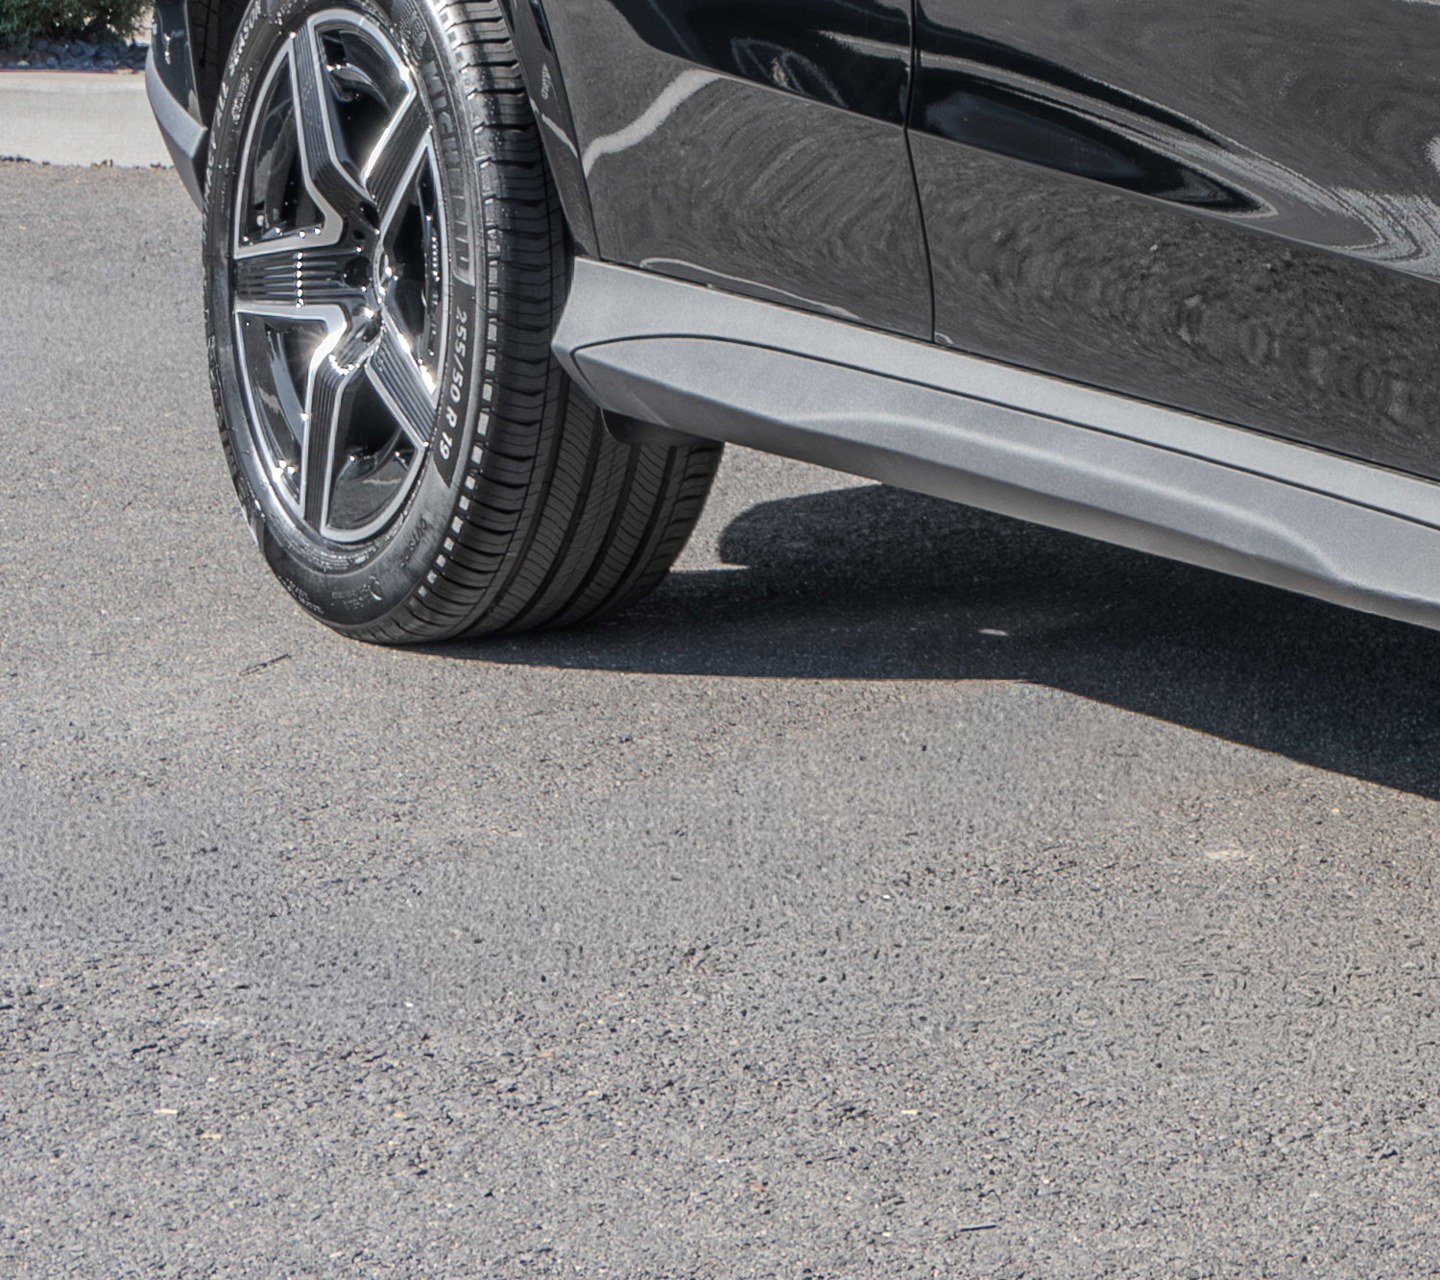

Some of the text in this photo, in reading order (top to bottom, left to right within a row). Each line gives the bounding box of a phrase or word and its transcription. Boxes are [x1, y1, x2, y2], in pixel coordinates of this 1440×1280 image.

[439, 305, 468, 461] 255/50 R 19
